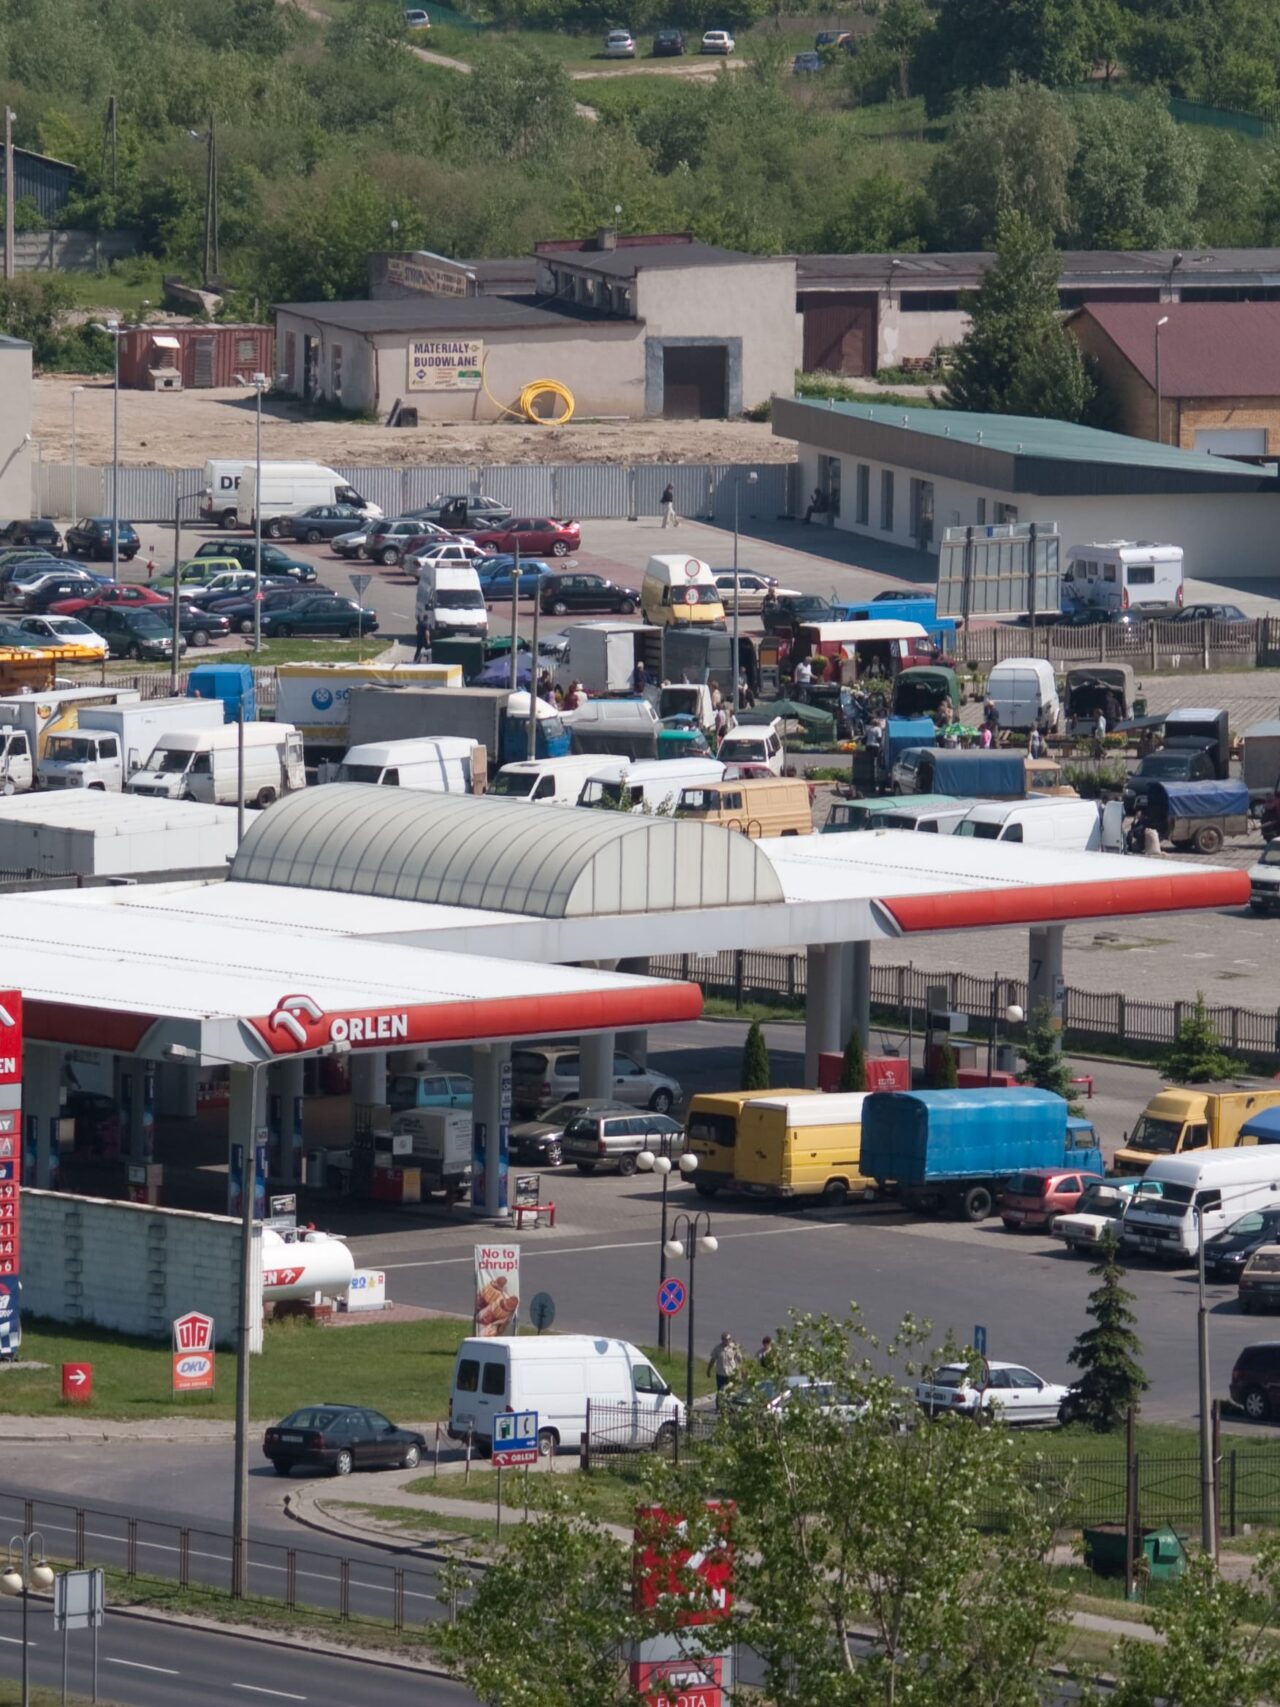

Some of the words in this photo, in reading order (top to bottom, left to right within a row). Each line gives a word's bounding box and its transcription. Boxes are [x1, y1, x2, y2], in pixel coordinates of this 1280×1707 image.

[414, 356, 478, 367] BUDOWLANE
[330, 1014, 408, 1041] ORLEN
[482, 1248, 500, 1259] No
[503, 1248, 515, 1259] to
[479, 1259, 518, 1272] chrup!
[179, 1315, 209, 1348] UTA
[181, 1361, 208, 1373] DKV
[511, 1452, 536, 1461] ORLEN
[657, 1694, 708, 1707] FOTA
